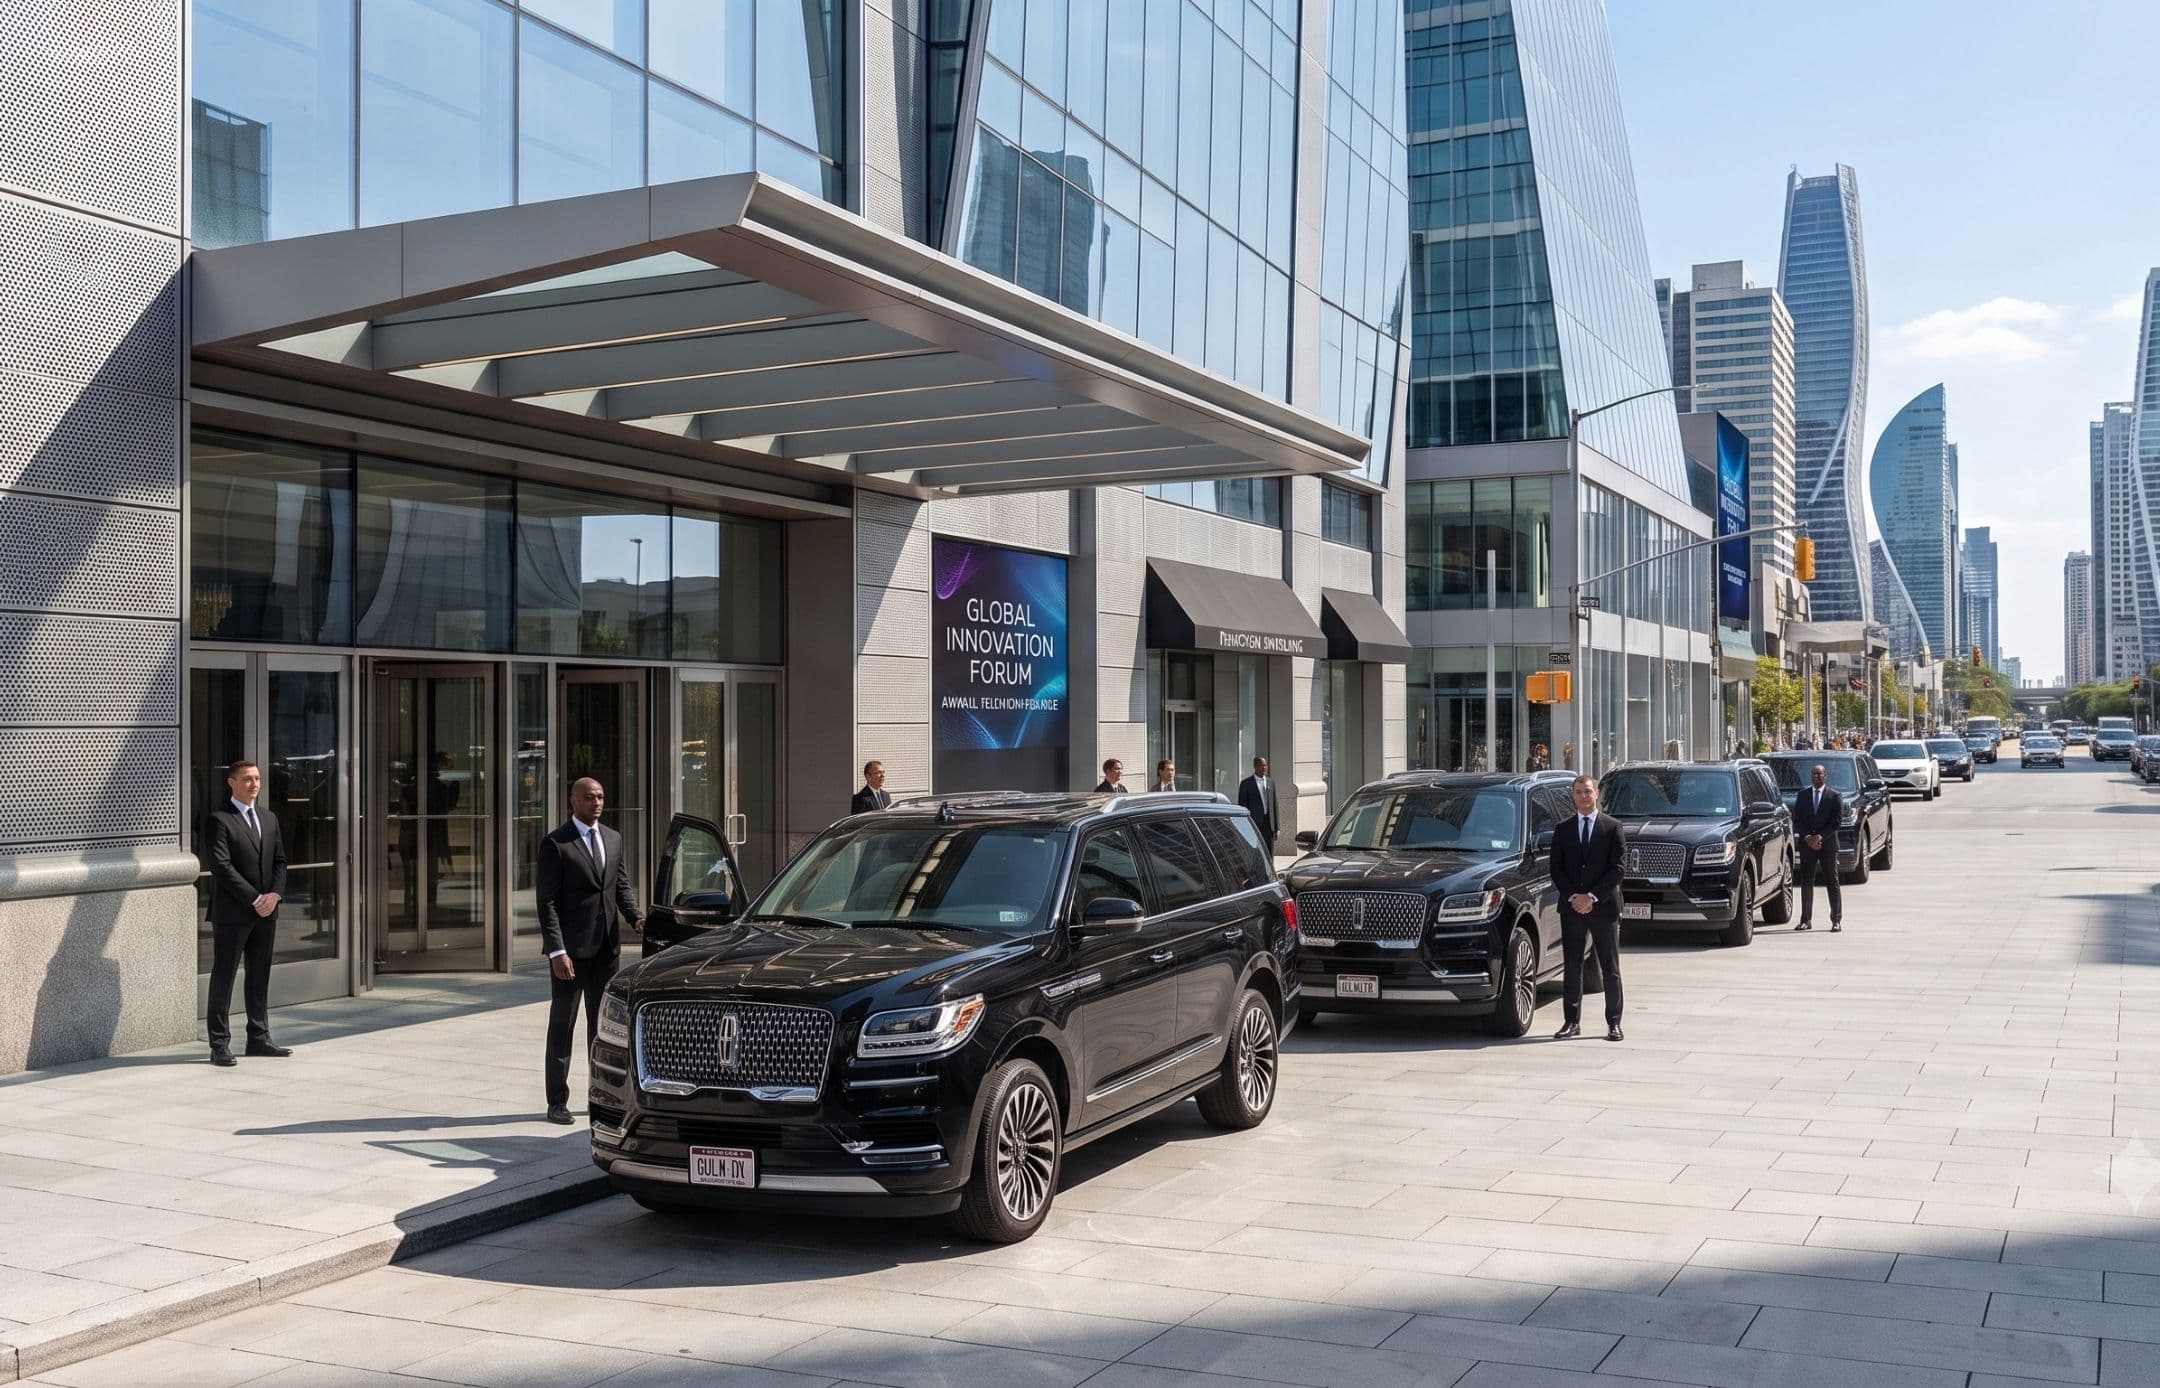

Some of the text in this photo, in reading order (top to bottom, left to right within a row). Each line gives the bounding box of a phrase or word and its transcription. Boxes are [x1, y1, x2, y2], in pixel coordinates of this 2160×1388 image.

[967, 598, 1035, 627] GLOBAL
[946, 626, 1054, 657] INNOVATION
[970, 660, 1032, 685] FORUM
